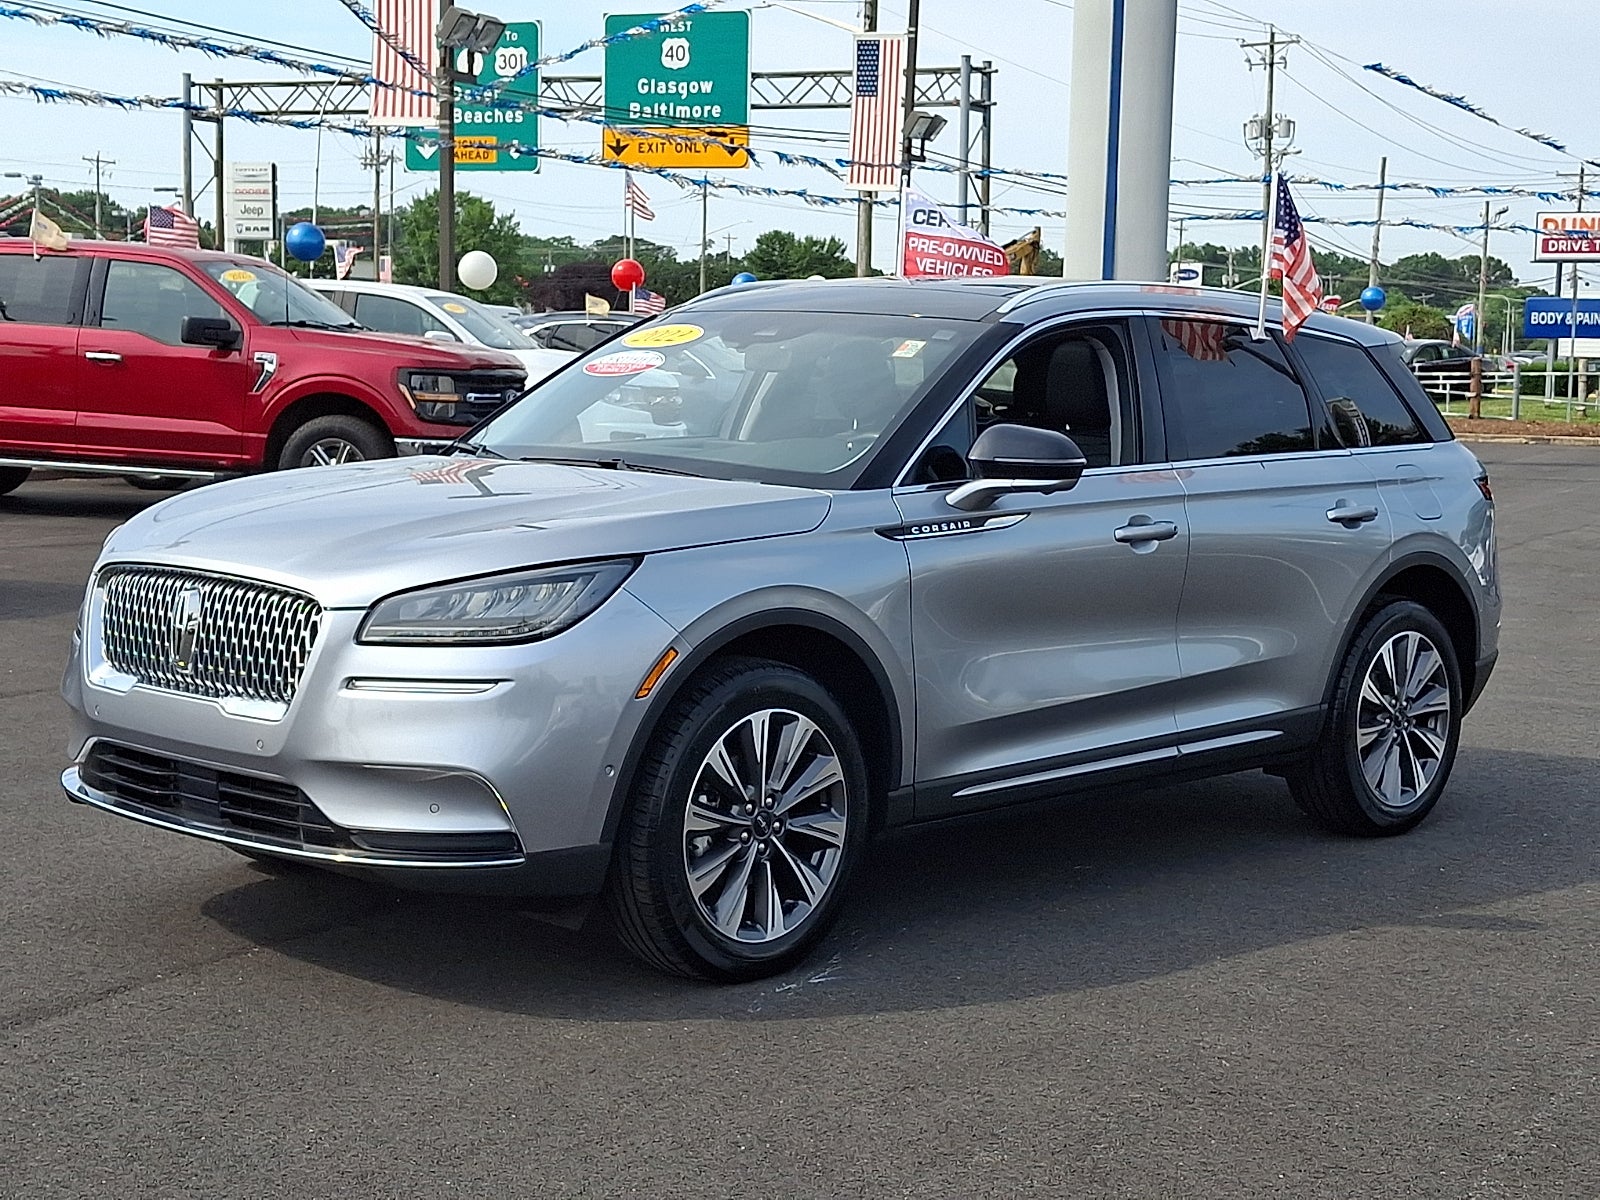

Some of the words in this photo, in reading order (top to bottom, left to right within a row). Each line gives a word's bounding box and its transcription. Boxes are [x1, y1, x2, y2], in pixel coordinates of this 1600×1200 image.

[505, 30, 518, 41] To
[664, 45, 686, 61] 40
[498, 53, 524, 70] 301
[637, 78, 714, 99] Glasgow
[453, 108, 524, 124] Beaches
[629, 102, 722, 119] Baltimore
[638, 142, 667, 153] EXIT
[674, 142, 710, 153] ONLY
[454, 150, 490, 160] AHEAD
[240, 204, 264, 217] Jeep
[1542, 217, 1600, 231] DUN
[908, 236, 1004, 267] PRE-OWNED
[1548, 239, 1591, 252] DRIVE
[915, 257, 994, 277] VEHICLES
[1530, 312, 1564, 325] BODY
[911, 520, 972, 534] CORSAIR
